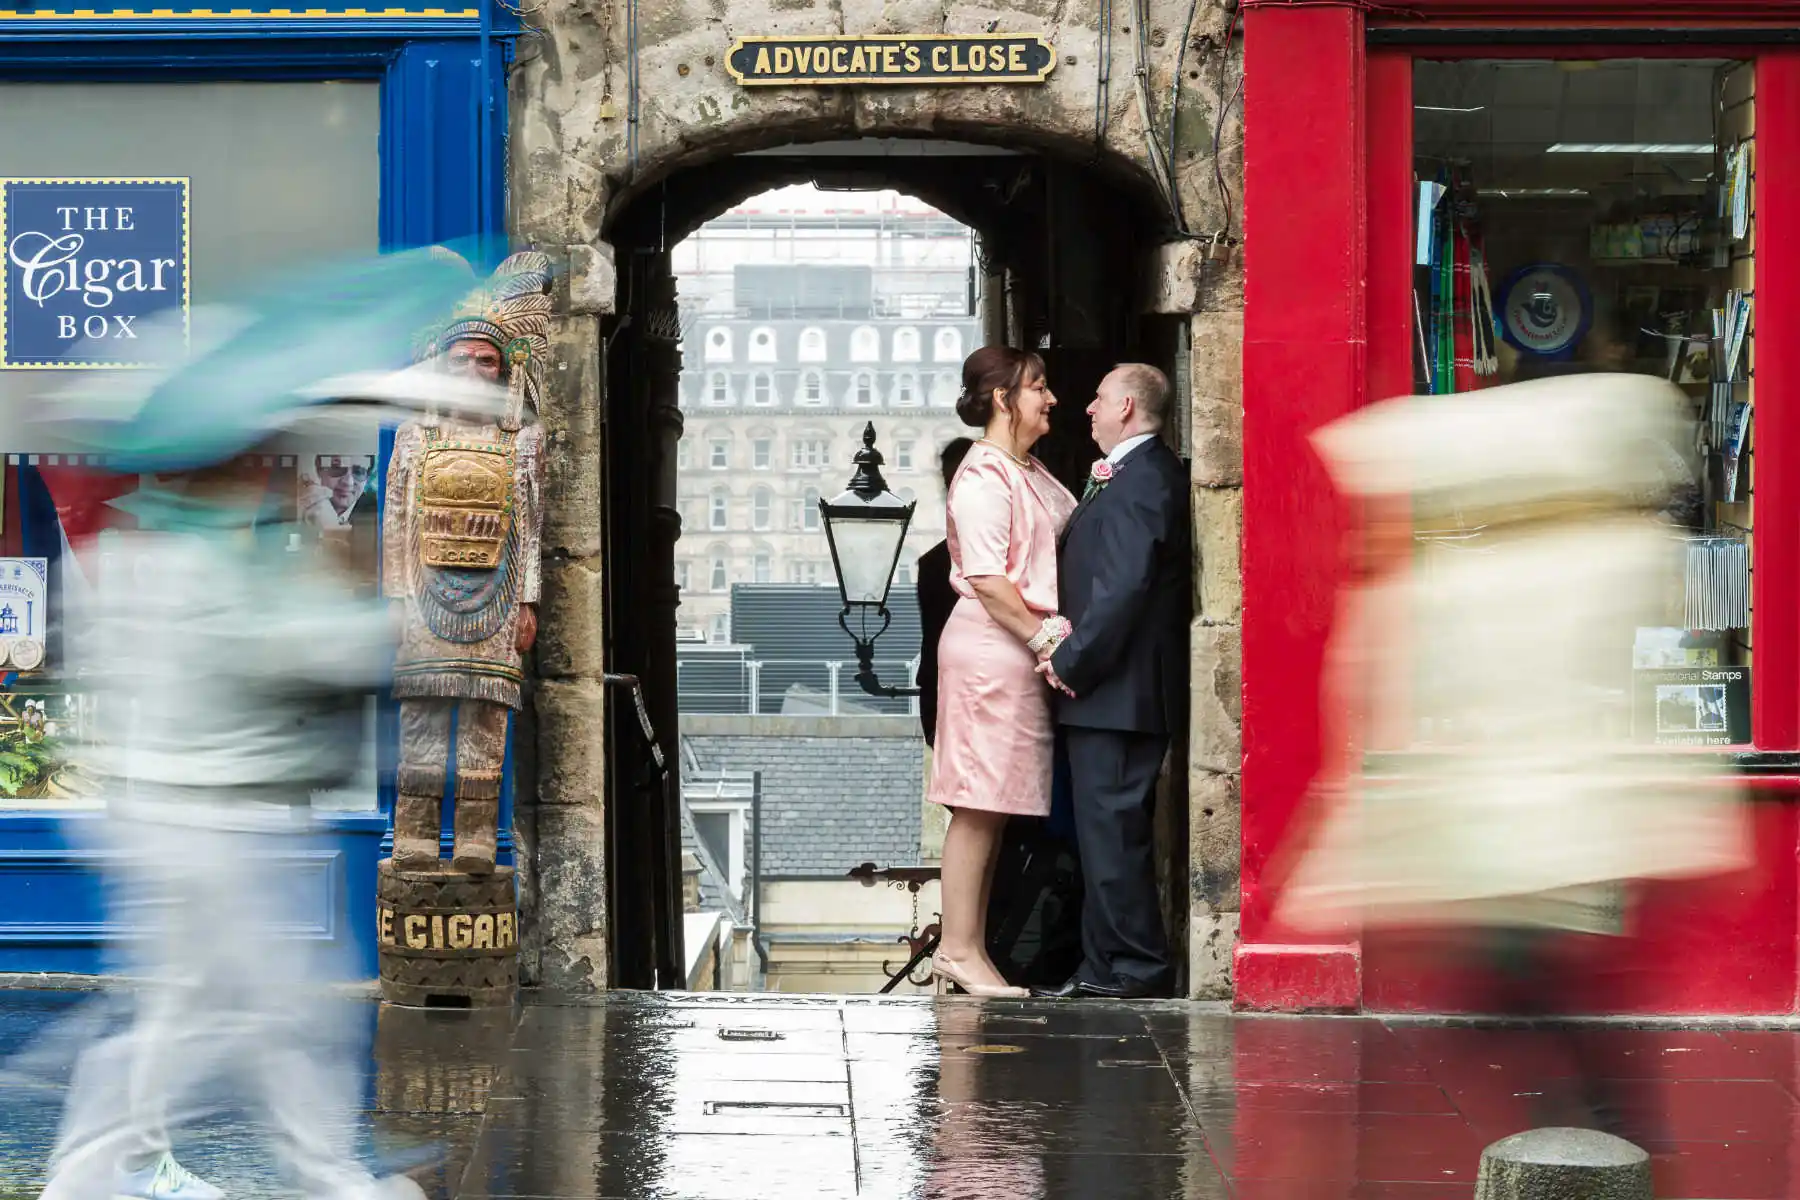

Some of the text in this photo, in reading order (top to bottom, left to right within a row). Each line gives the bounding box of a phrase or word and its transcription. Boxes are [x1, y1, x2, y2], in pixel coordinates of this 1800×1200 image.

[754, 41, 1028, 74] ADVOCATE'S CLOSE
[56, 207, 135, 231] THE
[9, 231, 176, 308] Cigar
[57, 315, 137, 339] BOX
[1702, 670, 1742, 683] Stamps
[1706, 734, 1731, 745] here
[404, 912, 513, 949] CIGAR
